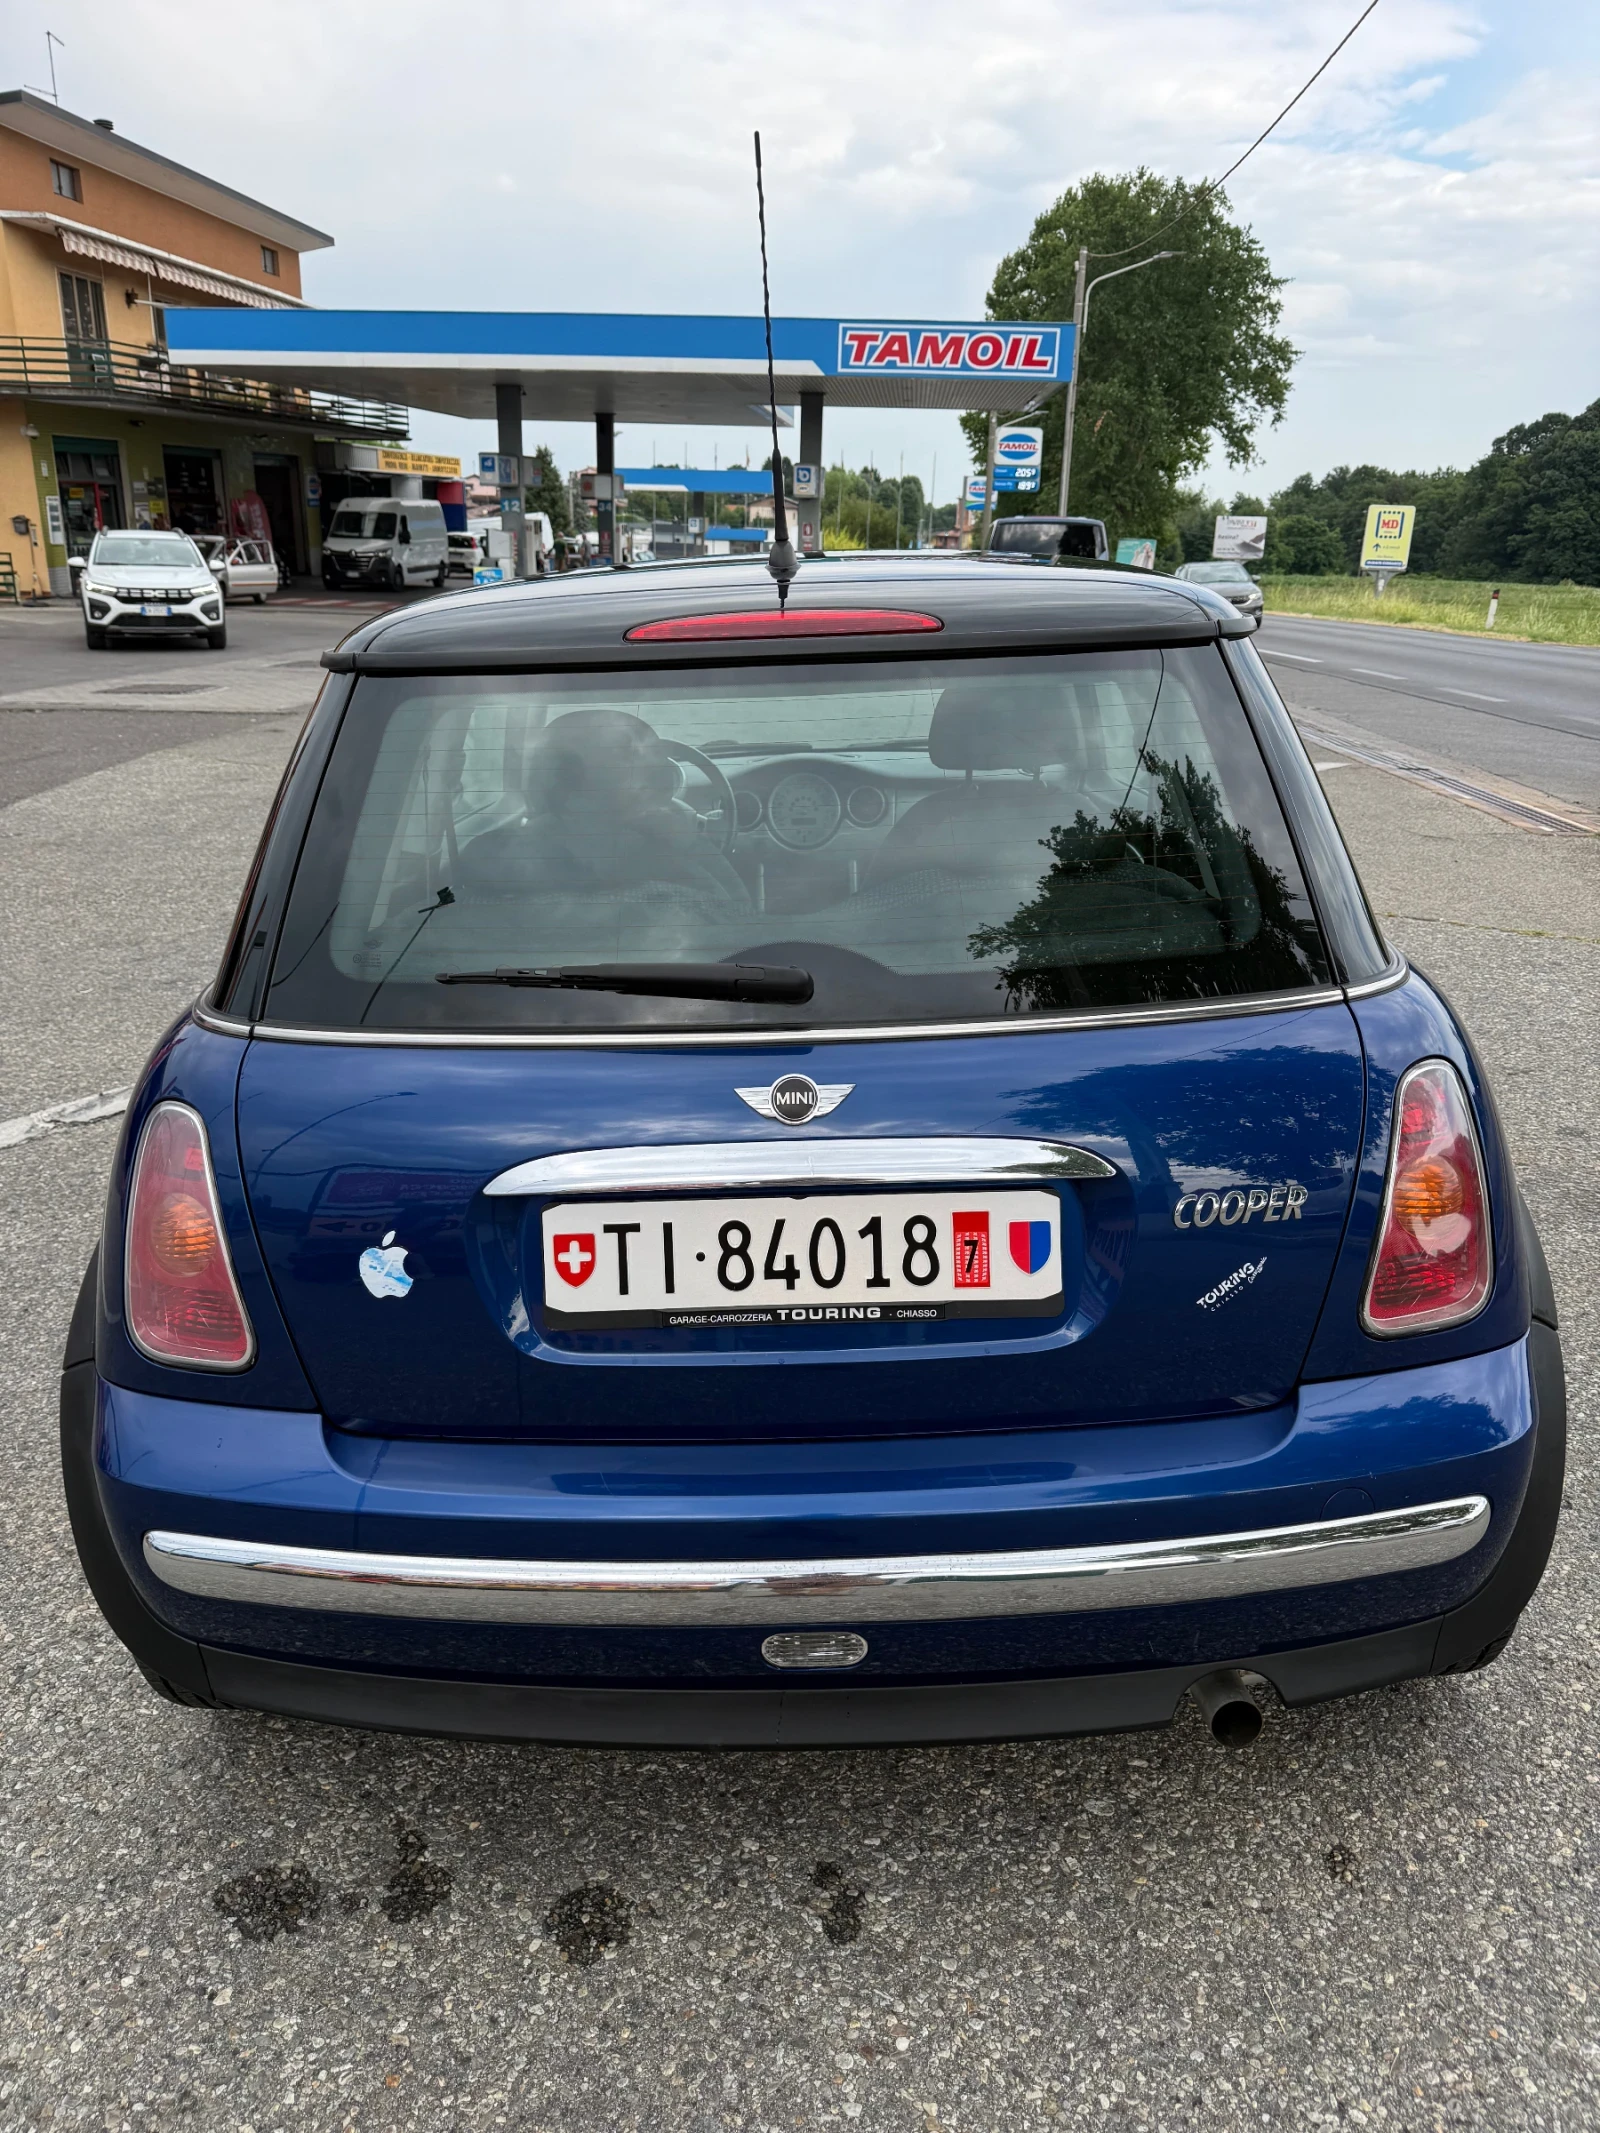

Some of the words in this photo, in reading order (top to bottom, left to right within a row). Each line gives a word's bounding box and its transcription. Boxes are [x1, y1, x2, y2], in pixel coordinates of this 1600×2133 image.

[845, 330, 1052, 370] TAMOIL
[998, 443, 1038, 451] TAMOIL
[503, 500, 520, 512] 12
[598, 502, 612, 512] 34
[1381, 519, 1399, 529] MD
[776, 1091, 814, 1106] MINI
[1173, 1185, 1308, 1229] COOPER
[963, 1239, 979, 1274] 7
[1196, 1262, 1255, 1308] TOURING
[669, 1312, 773, 1325] GARAGE-CARROZZERIA
[776, 1306, 881, 1321] TOURING
[896, 1309, 938, 1318] CHIASSO
